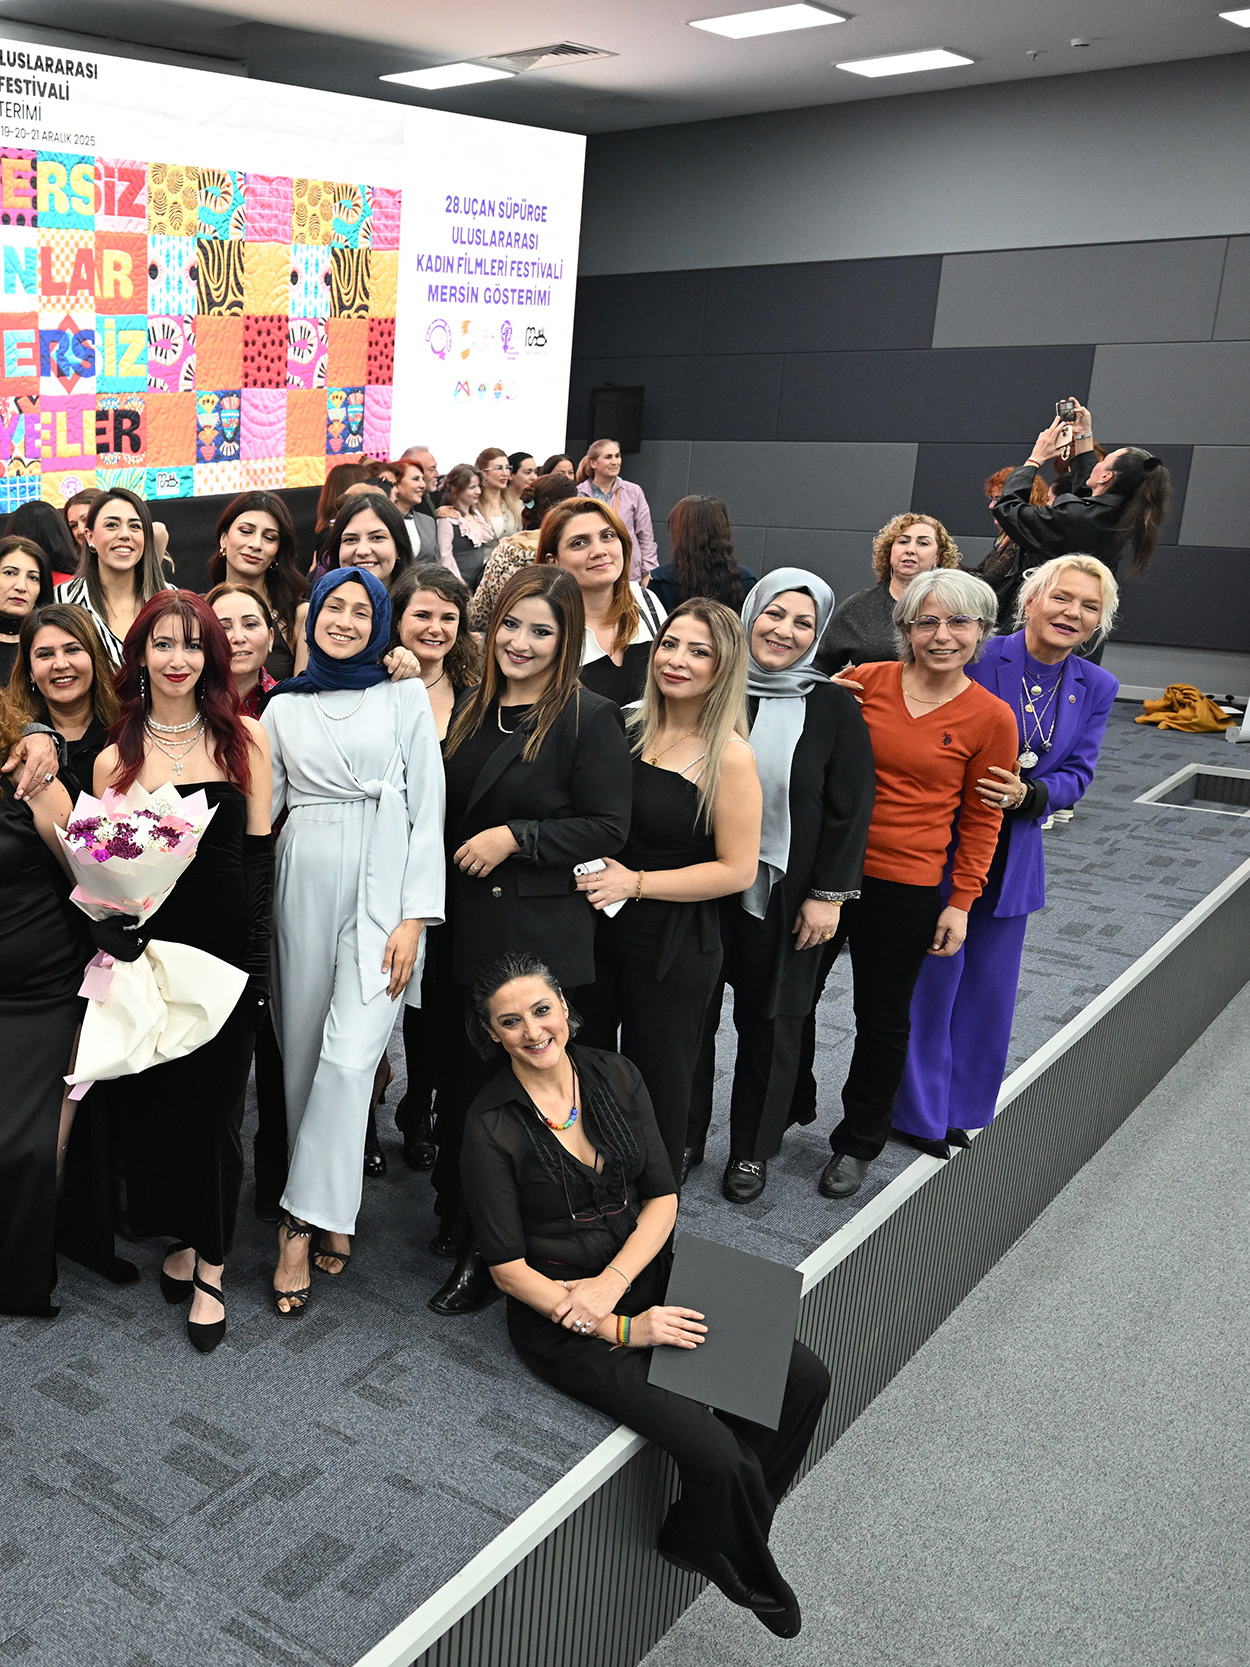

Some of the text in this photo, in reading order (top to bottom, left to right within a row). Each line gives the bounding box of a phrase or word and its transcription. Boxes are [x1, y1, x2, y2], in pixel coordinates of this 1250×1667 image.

[42, 129, 72, 144] ARALIK
[74, 132, 96, 146] 2025
[445, 195, 548, 223] 28.UÇAN SÜPÜRGE
[452, 226, 539, 250] ULUSLARARASI
[416, 252, 563, 280] KADIN FİLMLERİ FESTİVALİ
[427, 282, 551, 306] MERSİN GÖSTERİMİ
